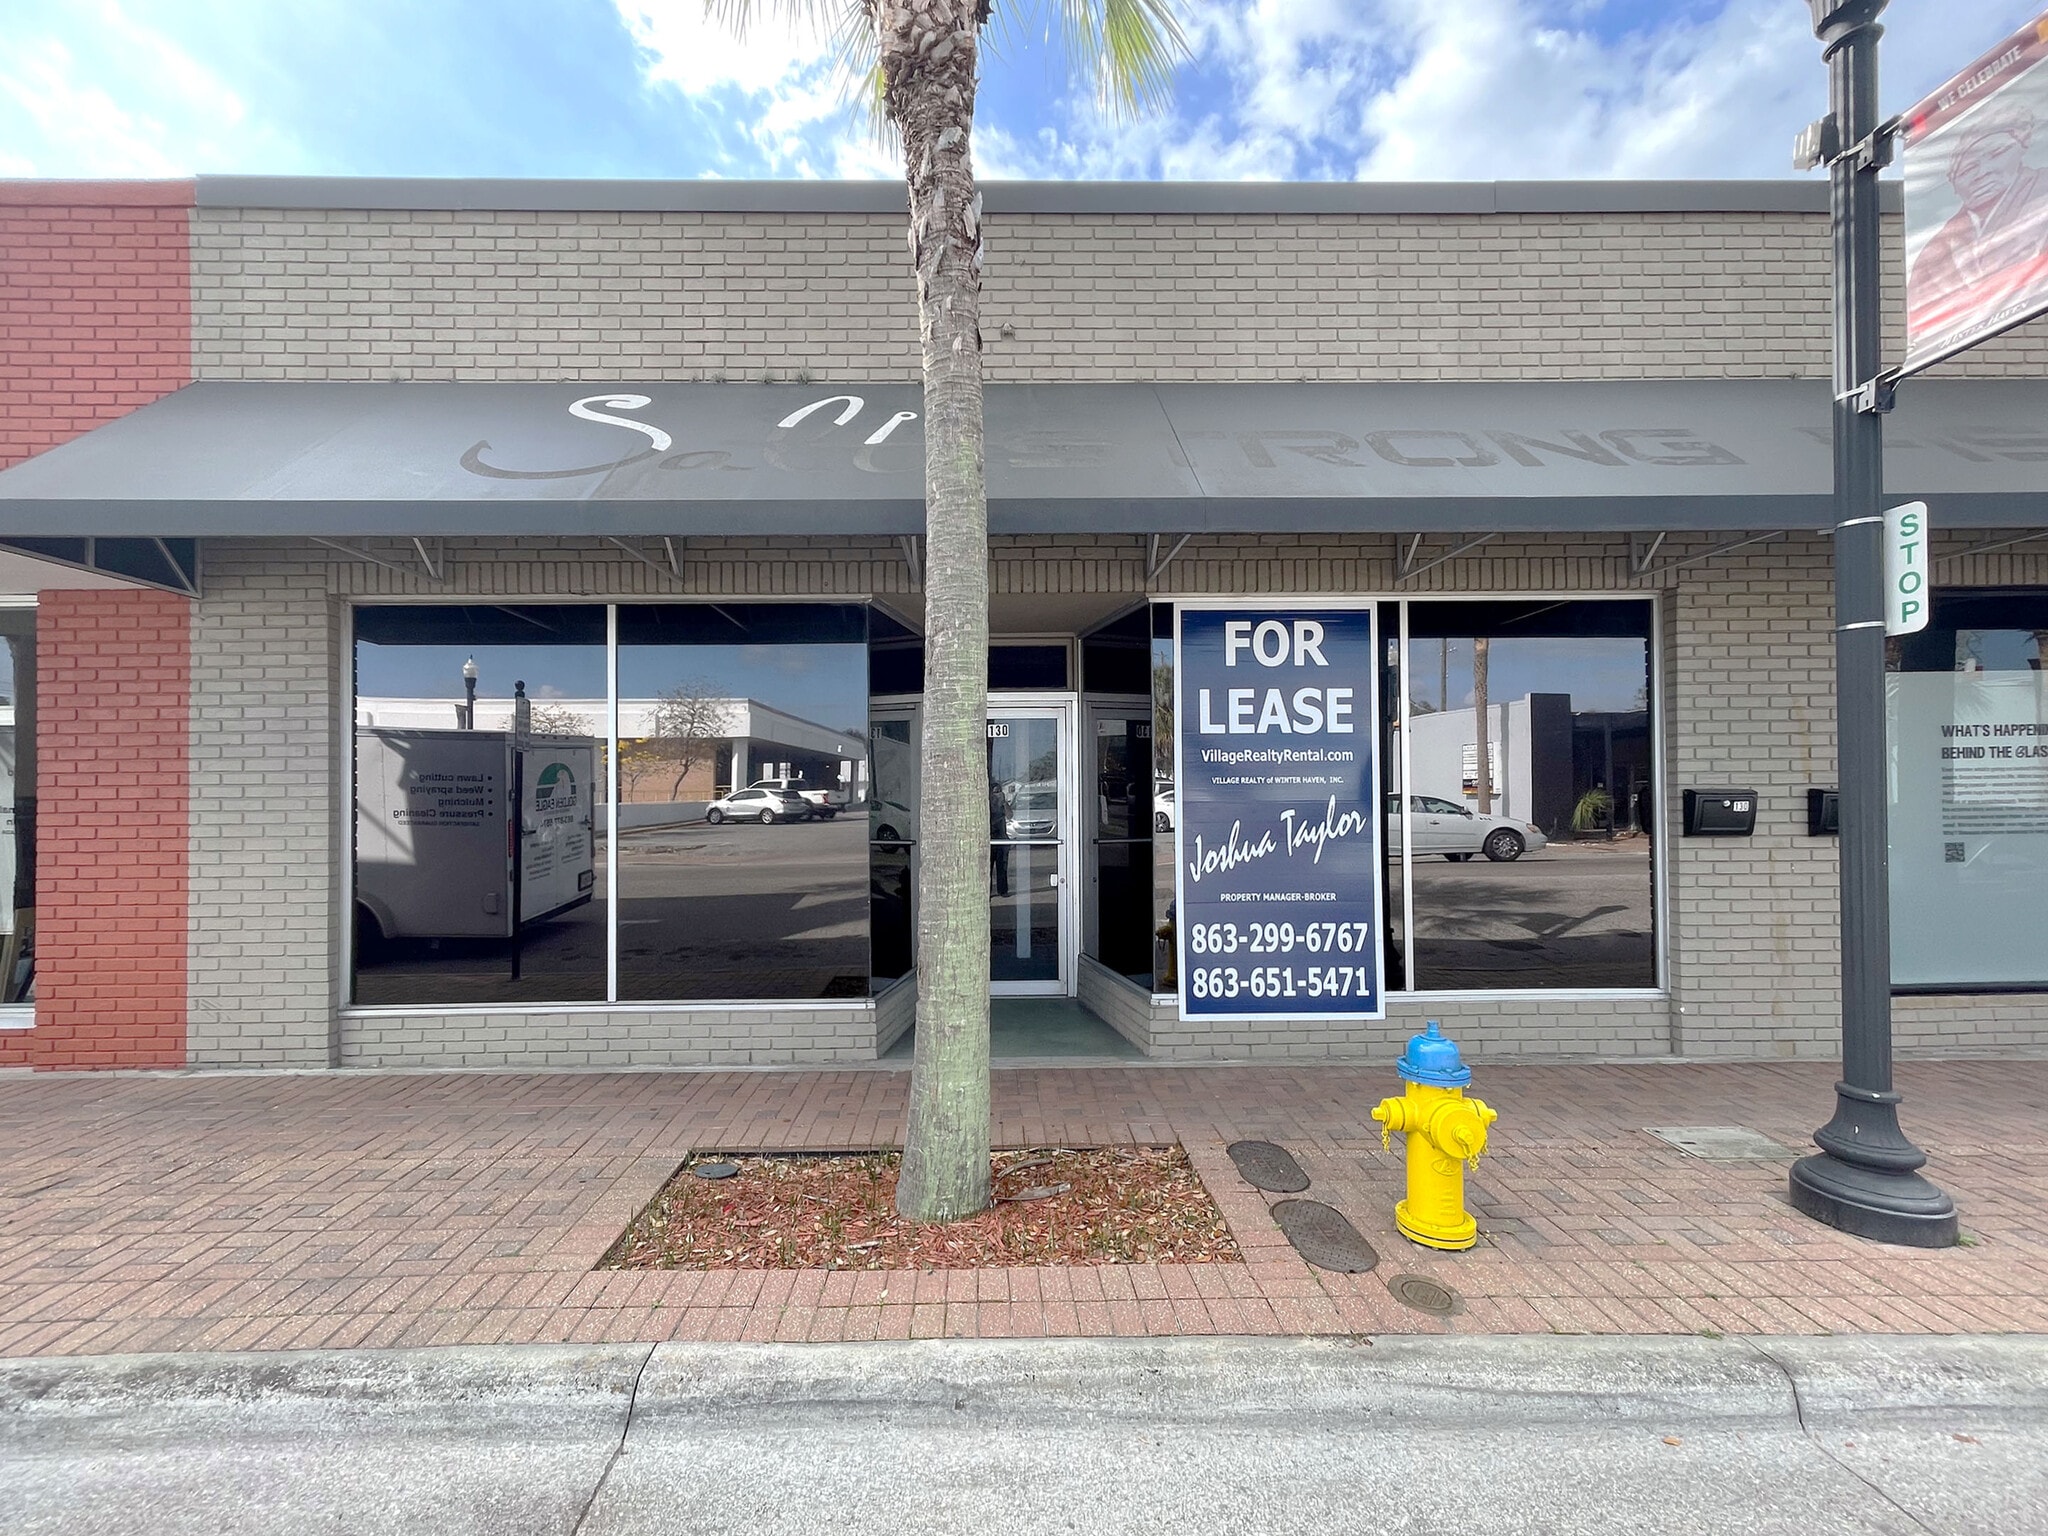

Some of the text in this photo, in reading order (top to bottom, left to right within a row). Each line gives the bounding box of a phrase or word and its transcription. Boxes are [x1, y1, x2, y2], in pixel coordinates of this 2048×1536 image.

[1938, 45, 2022, 111] WE CELEBRATE
[1899, 513, 1921, 623] STOP
[1225, 620, 1329, 667] FOR
[1199, 687, 1354, 734] LEASE
[989, 725, 1008, 736] 130
[1941, 724, 1990, 737] WHAT'S
[1201, 748, 1354, 765] VillageRealtyRental.com
[1941, 746, 1985, 759] BEHIND
[1988, 746, 2012, 758] THE
[1211, 775, 1344, 785] VILLAGE REALTY of WINTER HAVEN, INC.
[1189, 794, 1367, 883] Joshua Taylor
[1220, 892, 1337, 902] PROPERTY MANAGER-BROKER
[1191, 923, 1369, 954] 863-299-6767
[1192, 966, 1370, 998] 863-651-5471
